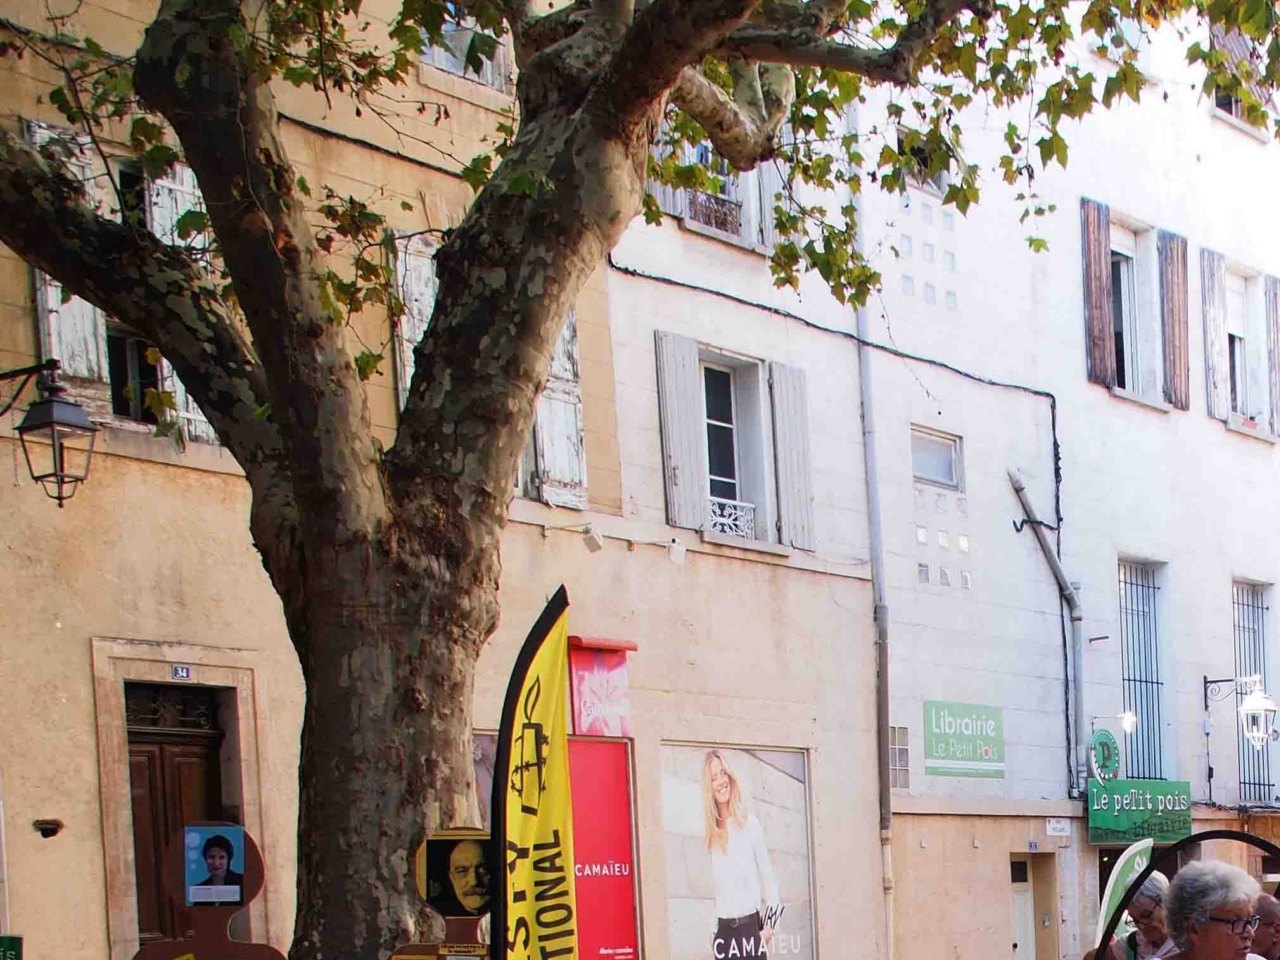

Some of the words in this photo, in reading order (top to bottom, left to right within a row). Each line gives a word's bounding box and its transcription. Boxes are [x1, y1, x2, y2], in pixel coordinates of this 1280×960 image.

[176, 666, 187, 678] 34
[932, 707, 996, 737] Librairie
[933, 737, 946, 757] Le
[949, 738, 973, 759] Petit
[977, 740, 998, 760] Pois
[1092, 788, 1109, 810] Le
[1158, 792, 1188, 815] pois
[575, 859, 630, 877] CAMAÏEU
